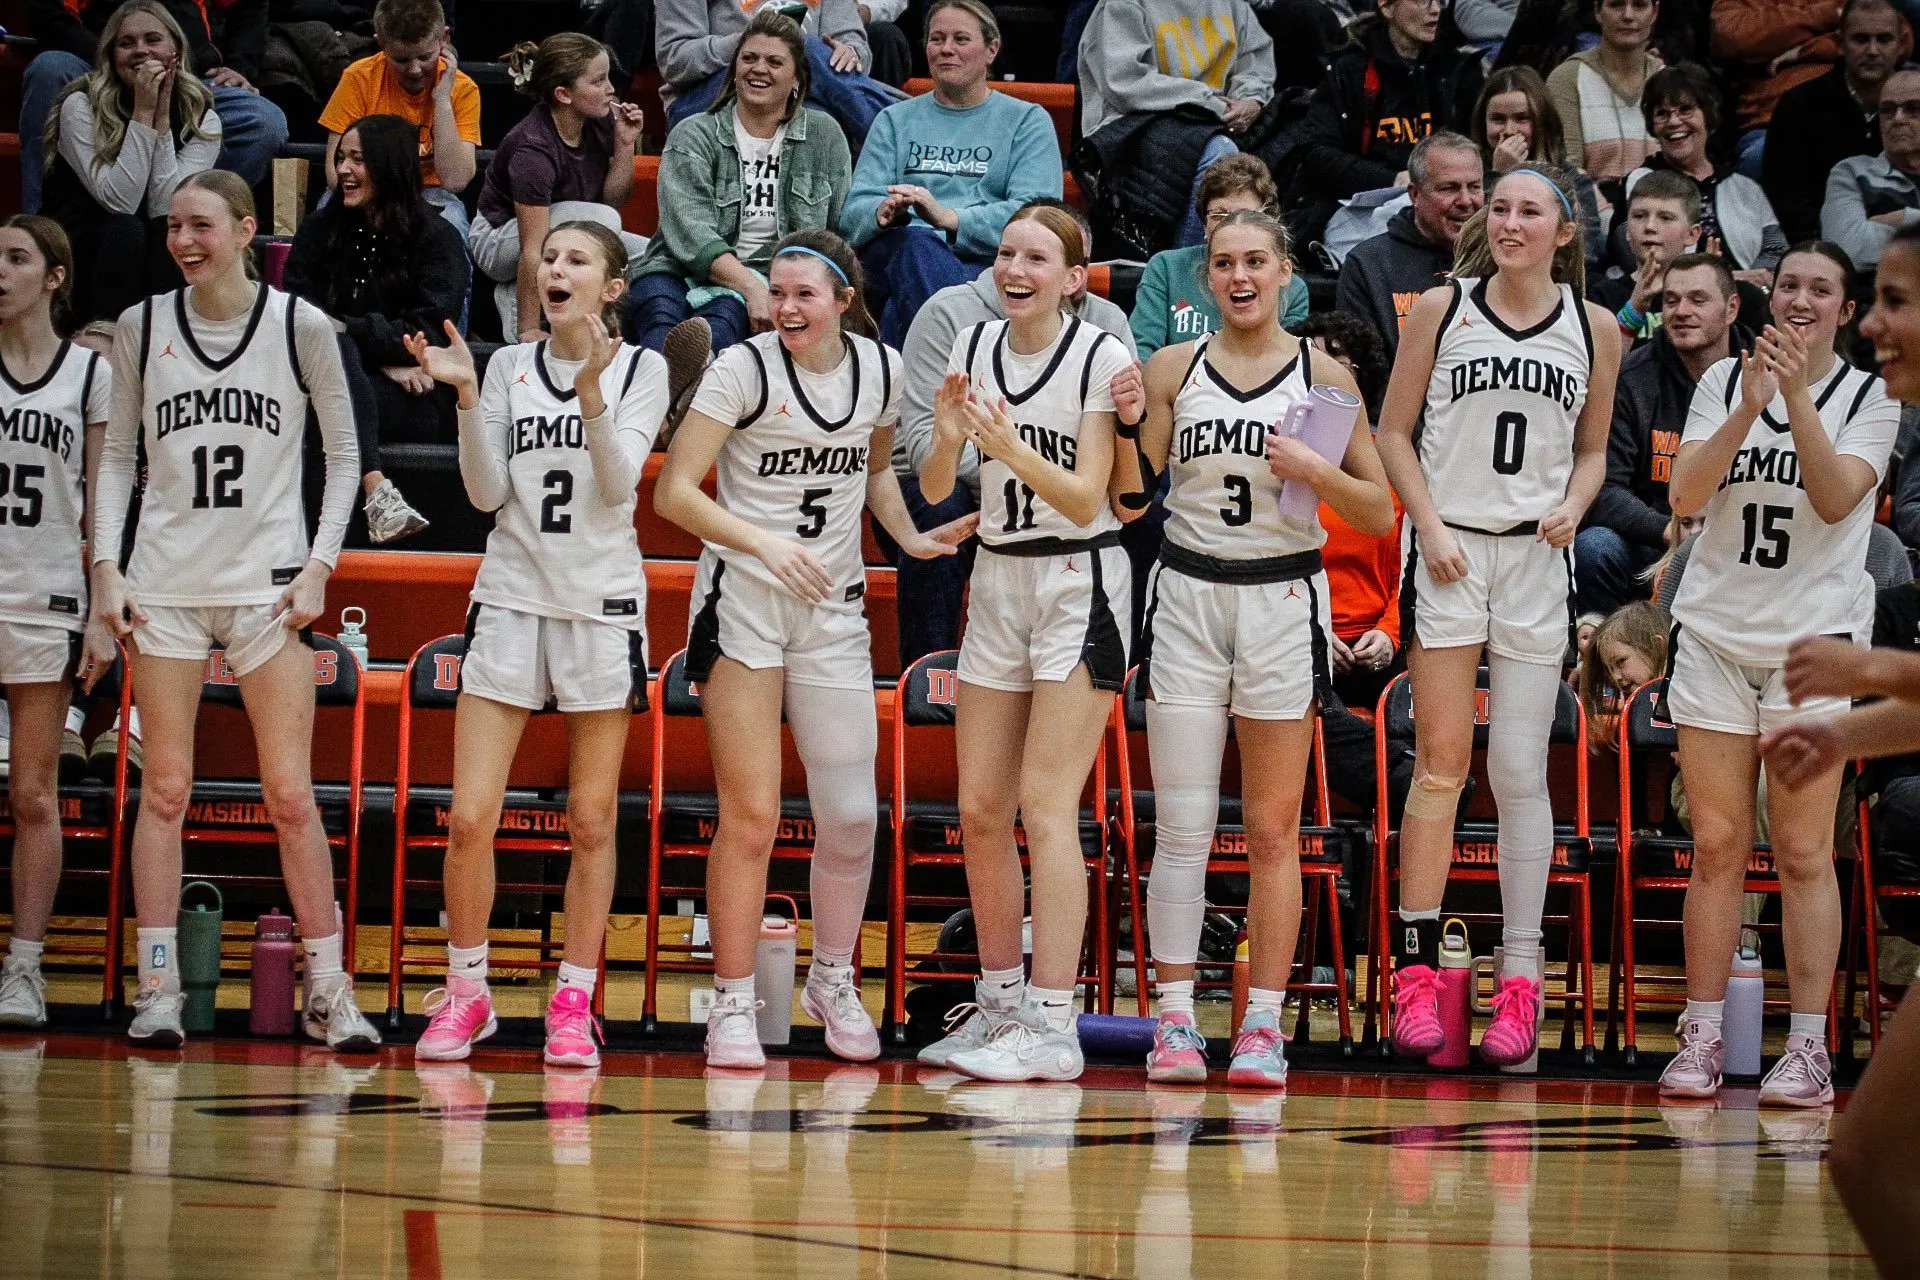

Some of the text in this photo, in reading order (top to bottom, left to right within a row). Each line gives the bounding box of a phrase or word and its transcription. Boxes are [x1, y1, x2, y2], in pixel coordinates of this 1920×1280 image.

[1450, 356, 1578, 412] DEMONS
[155, 387, 281, 441] DEMONS
[1179, 418, 1279, 465] DEMO
[1492, 410, 1528, 475] 0
[191, 444, 245, 510] 12
[539, 469, 574, 534] 2
[1219, 473, 1253, 527] 3
[795, 487, 833, 539] 5
[1002, 478, 1039, 533] 11
[1738, 502, 1795, 570] 15
